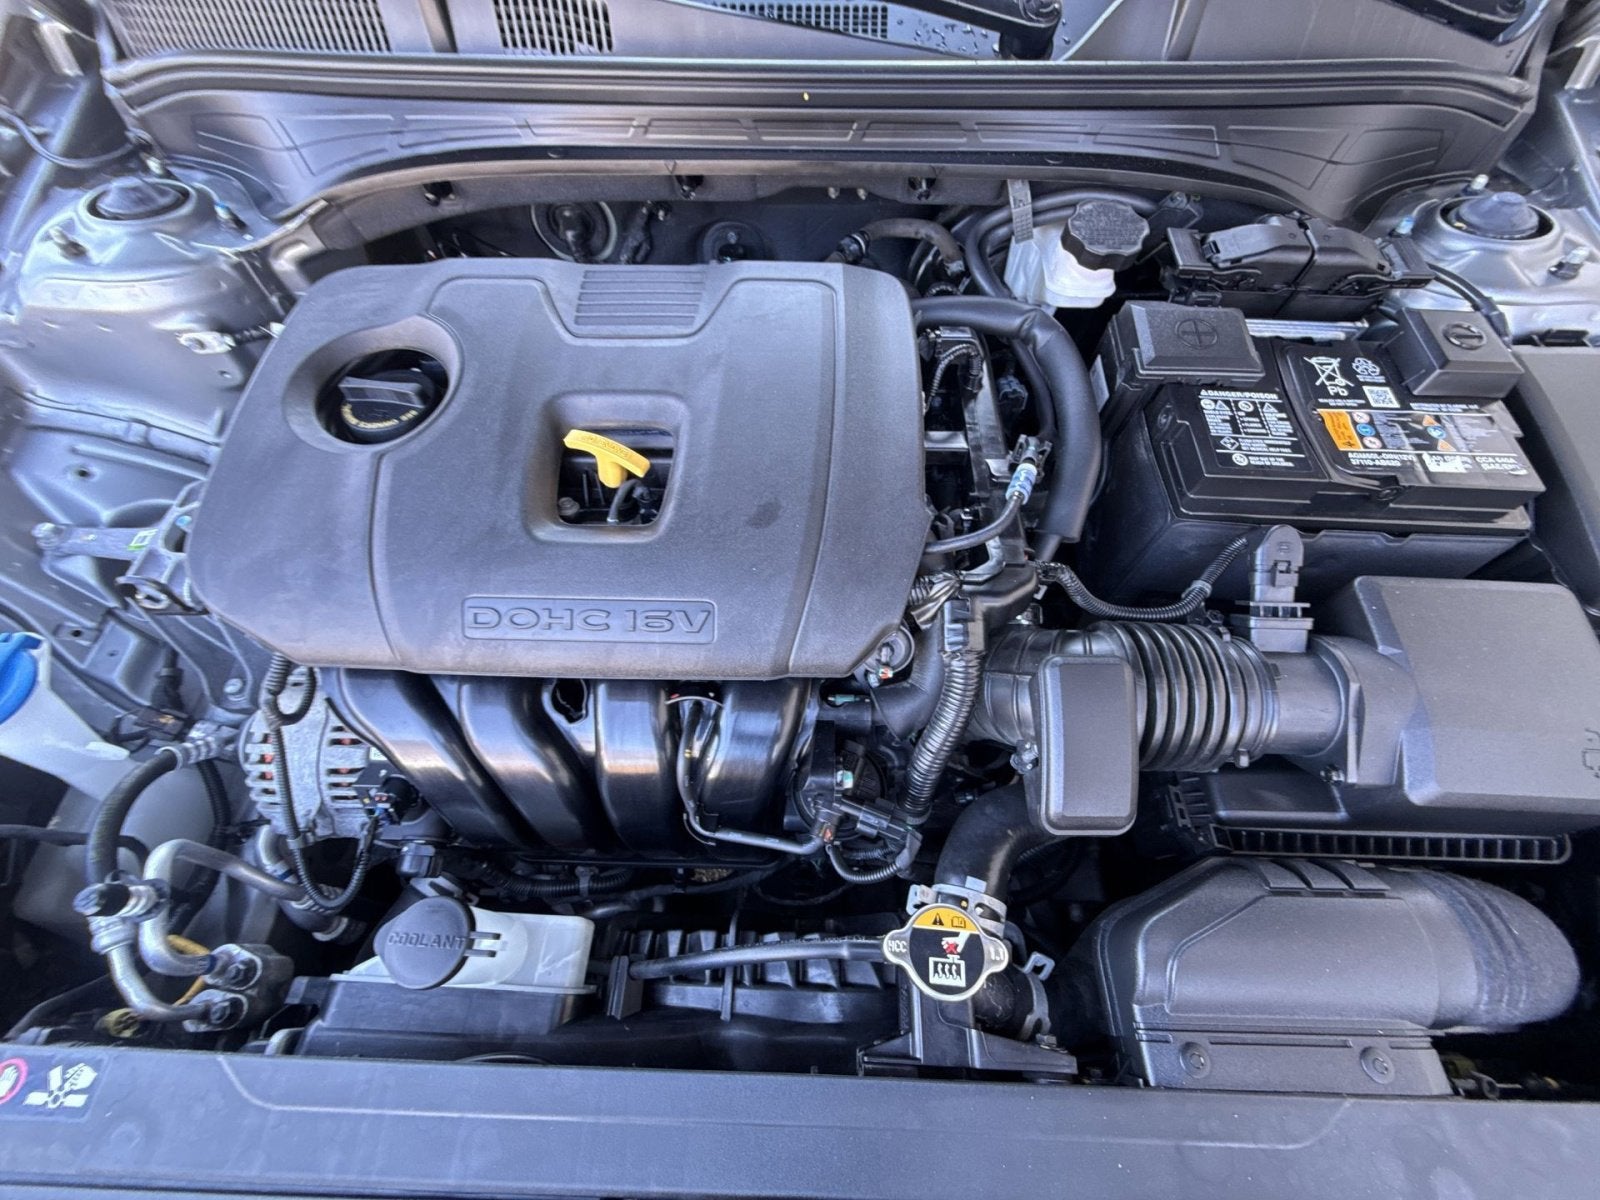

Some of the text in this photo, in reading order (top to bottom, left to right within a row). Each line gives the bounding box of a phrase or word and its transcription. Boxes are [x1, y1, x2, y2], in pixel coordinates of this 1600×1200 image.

[1327, 386, 1349, 397] Pb
[466, 606, 712, 634] DOHC 16V
[387, 932, 468, 950] COOLANT
[888, 940, 908, 954] HCC
